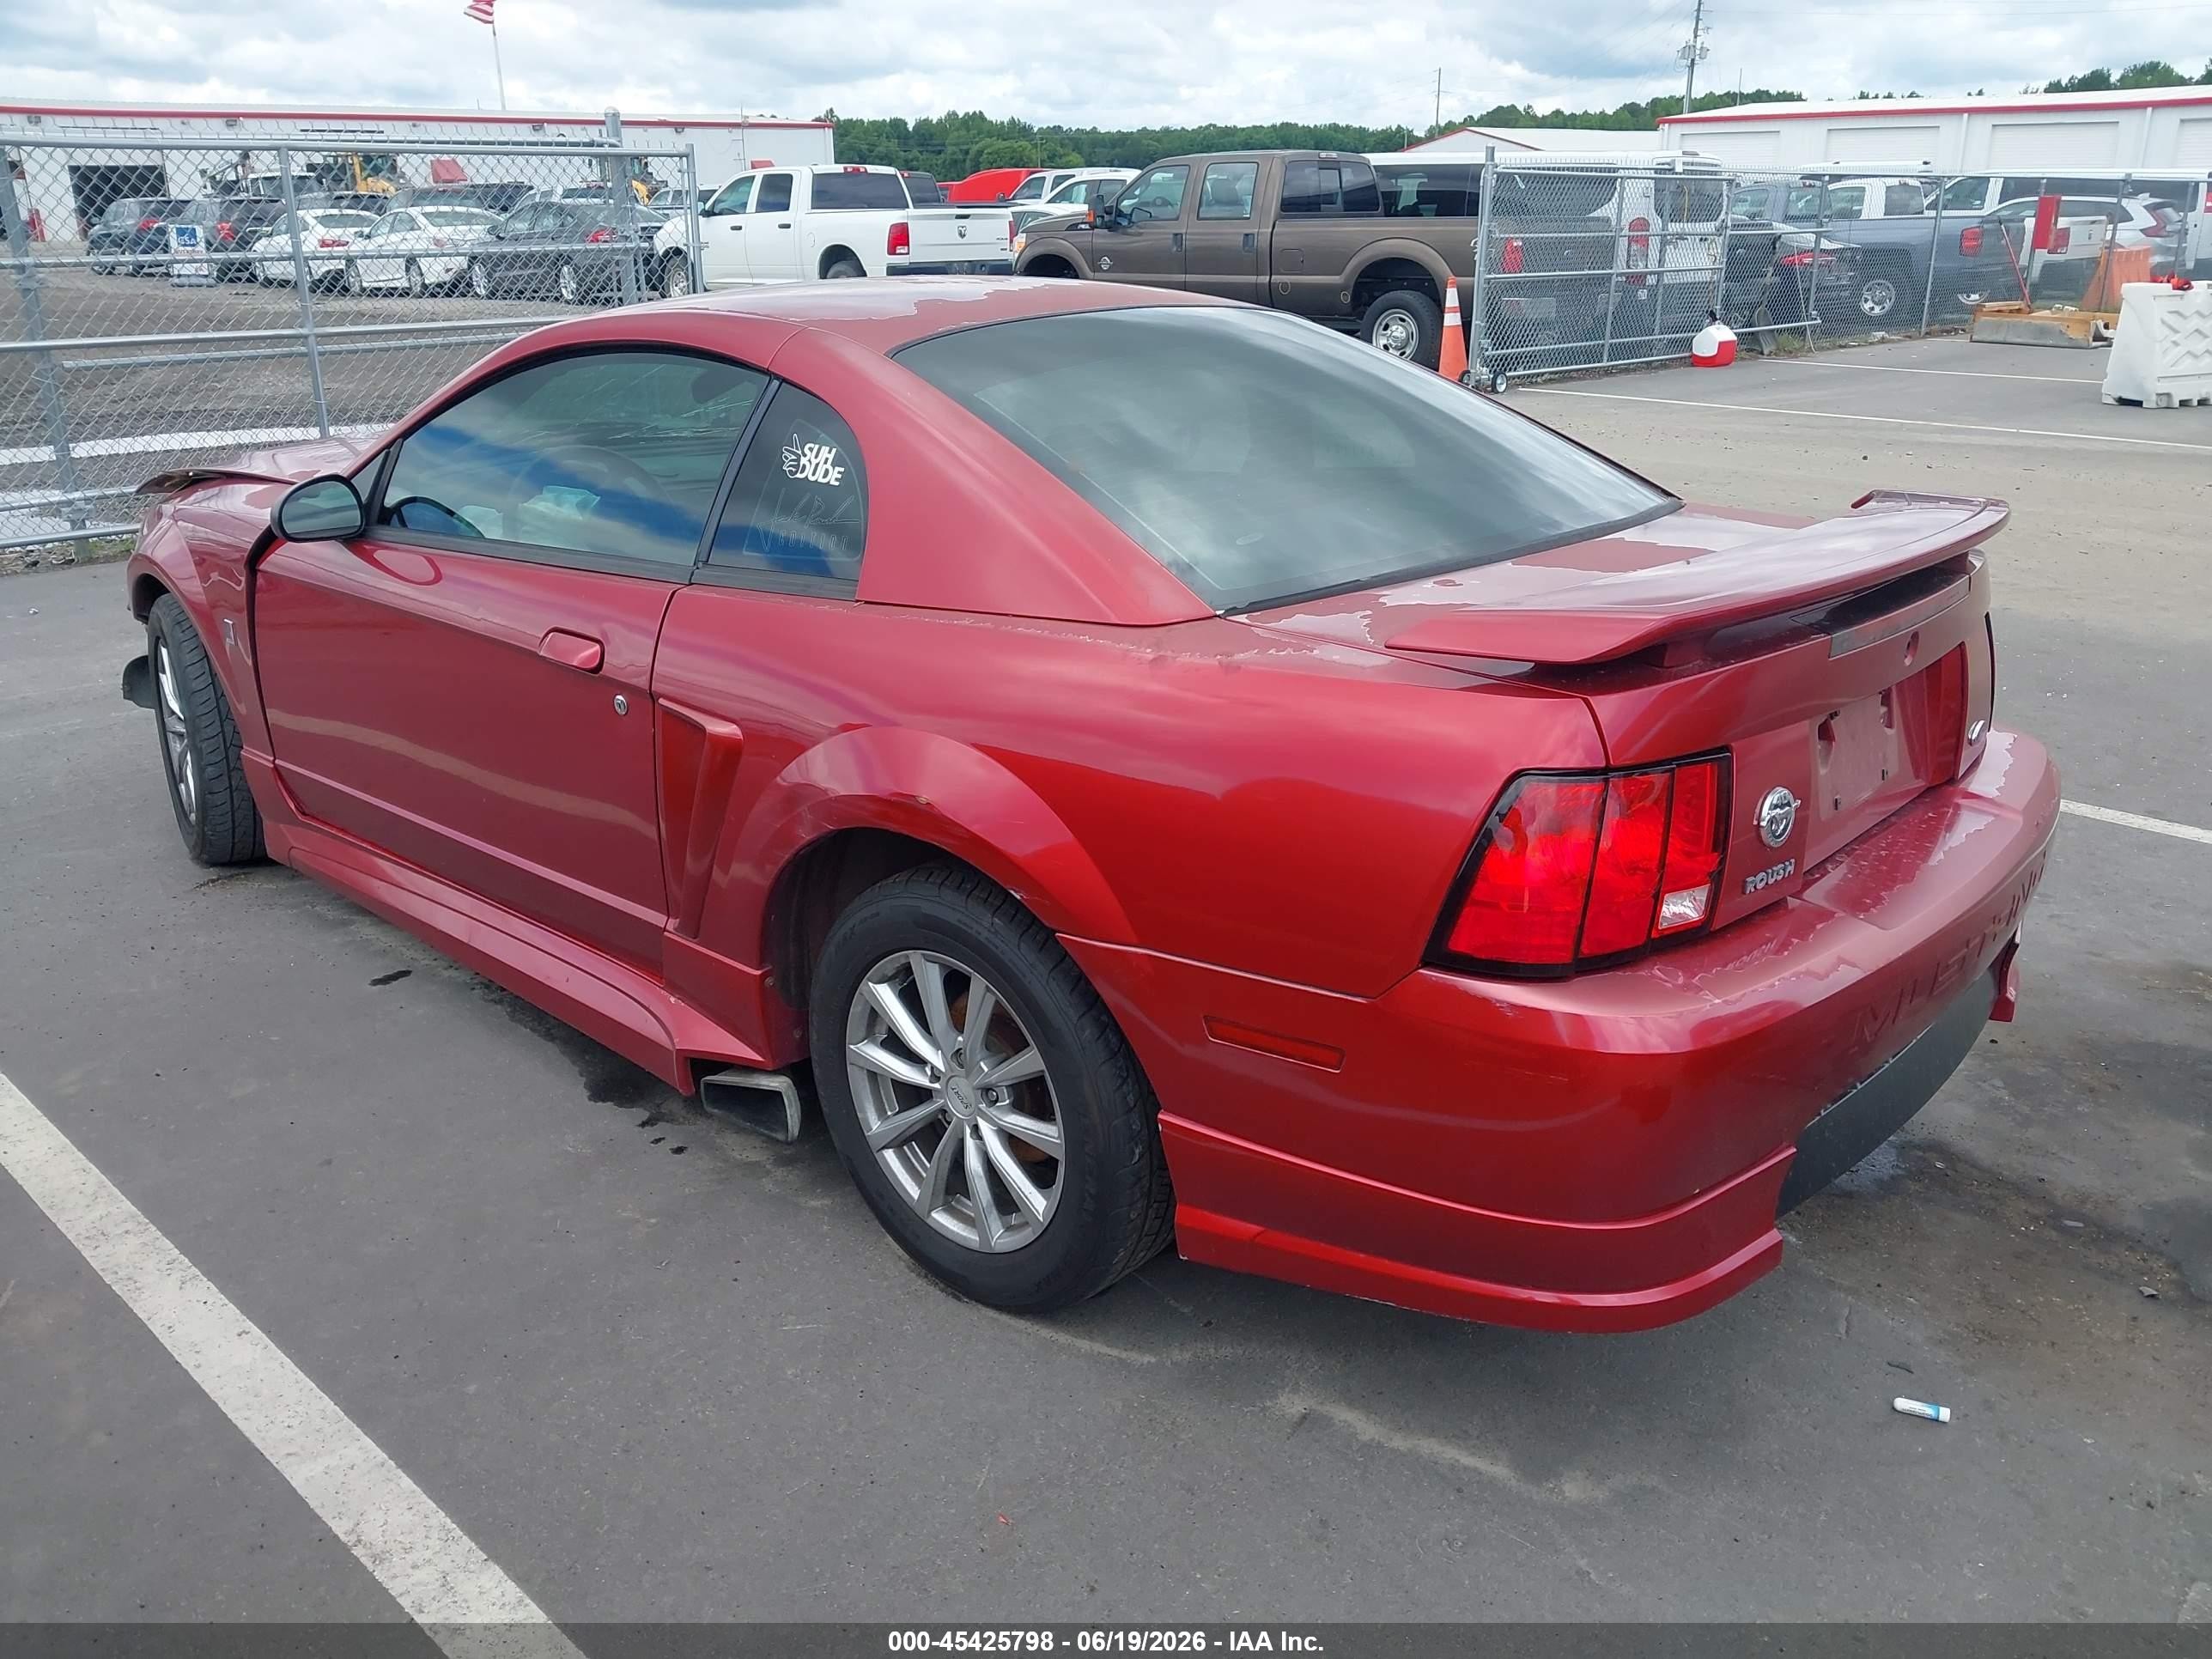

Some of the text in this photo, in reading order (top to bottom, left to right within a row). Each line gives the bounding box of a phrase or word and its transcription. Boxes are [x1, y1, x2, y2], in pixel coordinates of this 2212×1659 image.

[178, 236, 197, 245] GSA
[802, 442, 837, 466] SUH
[797, 459, 845, 486] DUDE
[1744, 859, 1796, 895] ROUSH
[951, 1085, 972, 1110] SPORT
